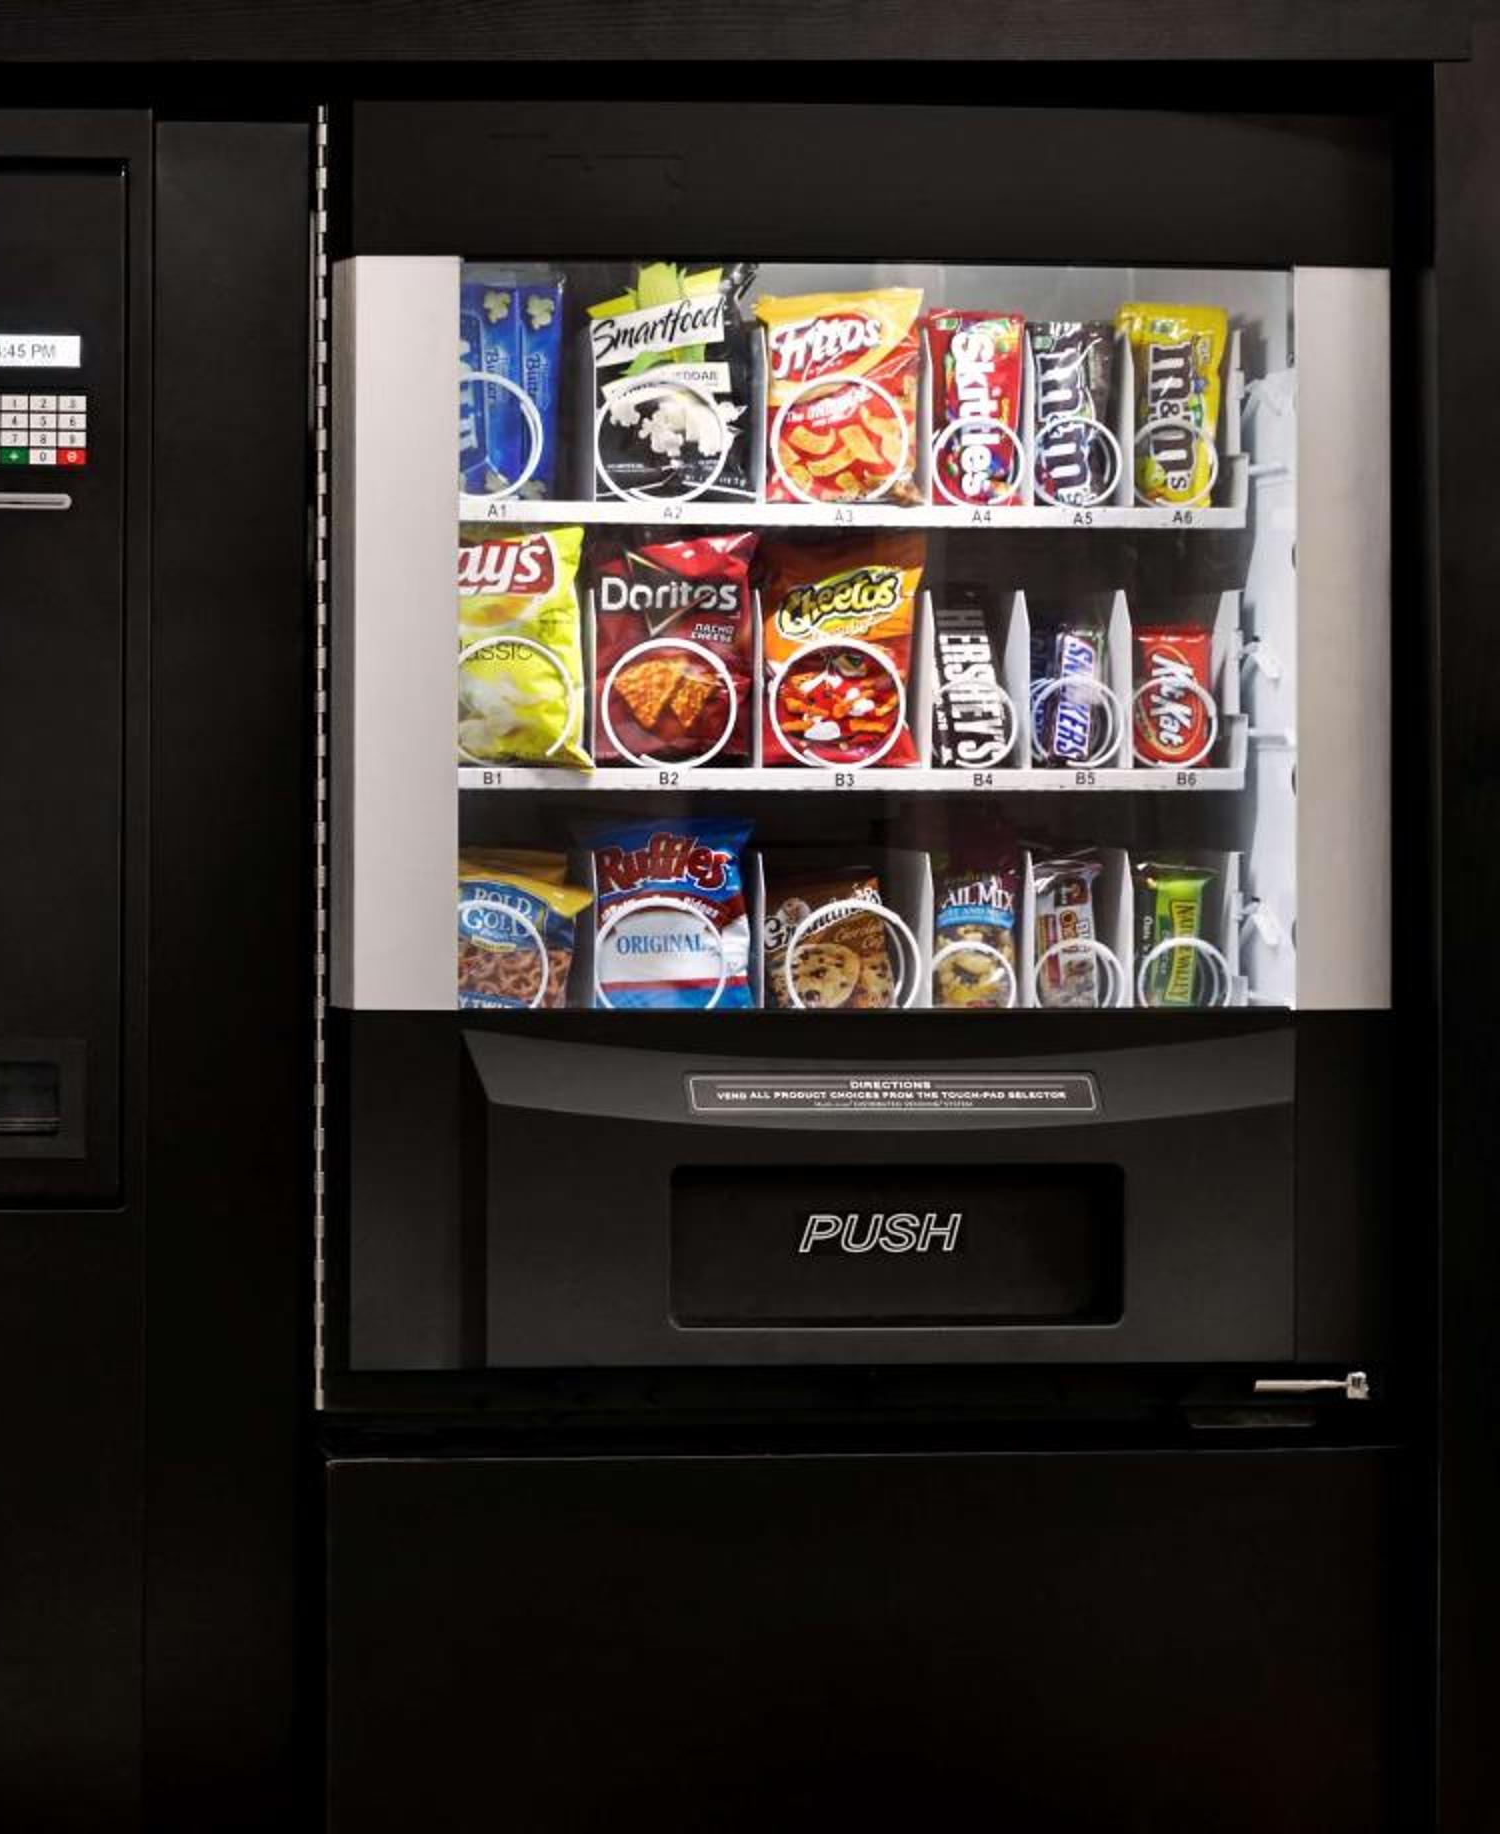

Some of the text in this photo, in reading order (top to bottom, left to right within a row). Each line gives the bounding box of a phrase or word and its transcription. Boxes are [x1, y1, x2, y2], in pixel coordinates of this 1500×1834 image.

[593, 296, 727, 360] Smartfood
[31, 343, 56, 359] PM
[770, 319, 881, 378] Fritos
[952, 331, 1001, 495] Skittles
[488, 505, 507, 517] A1
[664, 506, 683, 519] A2
[835, 509, 853, 521] A3
[972, 511, 991, 523] A4
[1172, 511, 1193, 523] A6
[1073, 512, 1093, 525] A5
[458, 541, 546, 595] ay's
[601, 576, 738, 611] Doritos
[780, 571, 899, 636] Cheetos
[459, 639, 534, 662] lassic
[936, 609, 1006, 761] HERSHEY'S
[1151, 694, 1193, 747] Kat
[484, 772, 502, 785] B1
[659, 772, 679, 785] B2
[836, 773, 855, 786] B3
[974, 773, 992, 786] B4
[1076, 772, 1096, 785] B5
[1177, 772, 1197, 785] B6
[596, 831, 733, 892] Ruffles
[617, 933, 704, 955] ORIGINAL
[850, 1081, 932, 1089] DIRECTIONS
[717, 1091, 1066, 1099] VEND ALL PRODUCT CHOICES FROM THE TOUCH-PAD SELECTOR
[799, 1213, 963, 1252] PUSH
